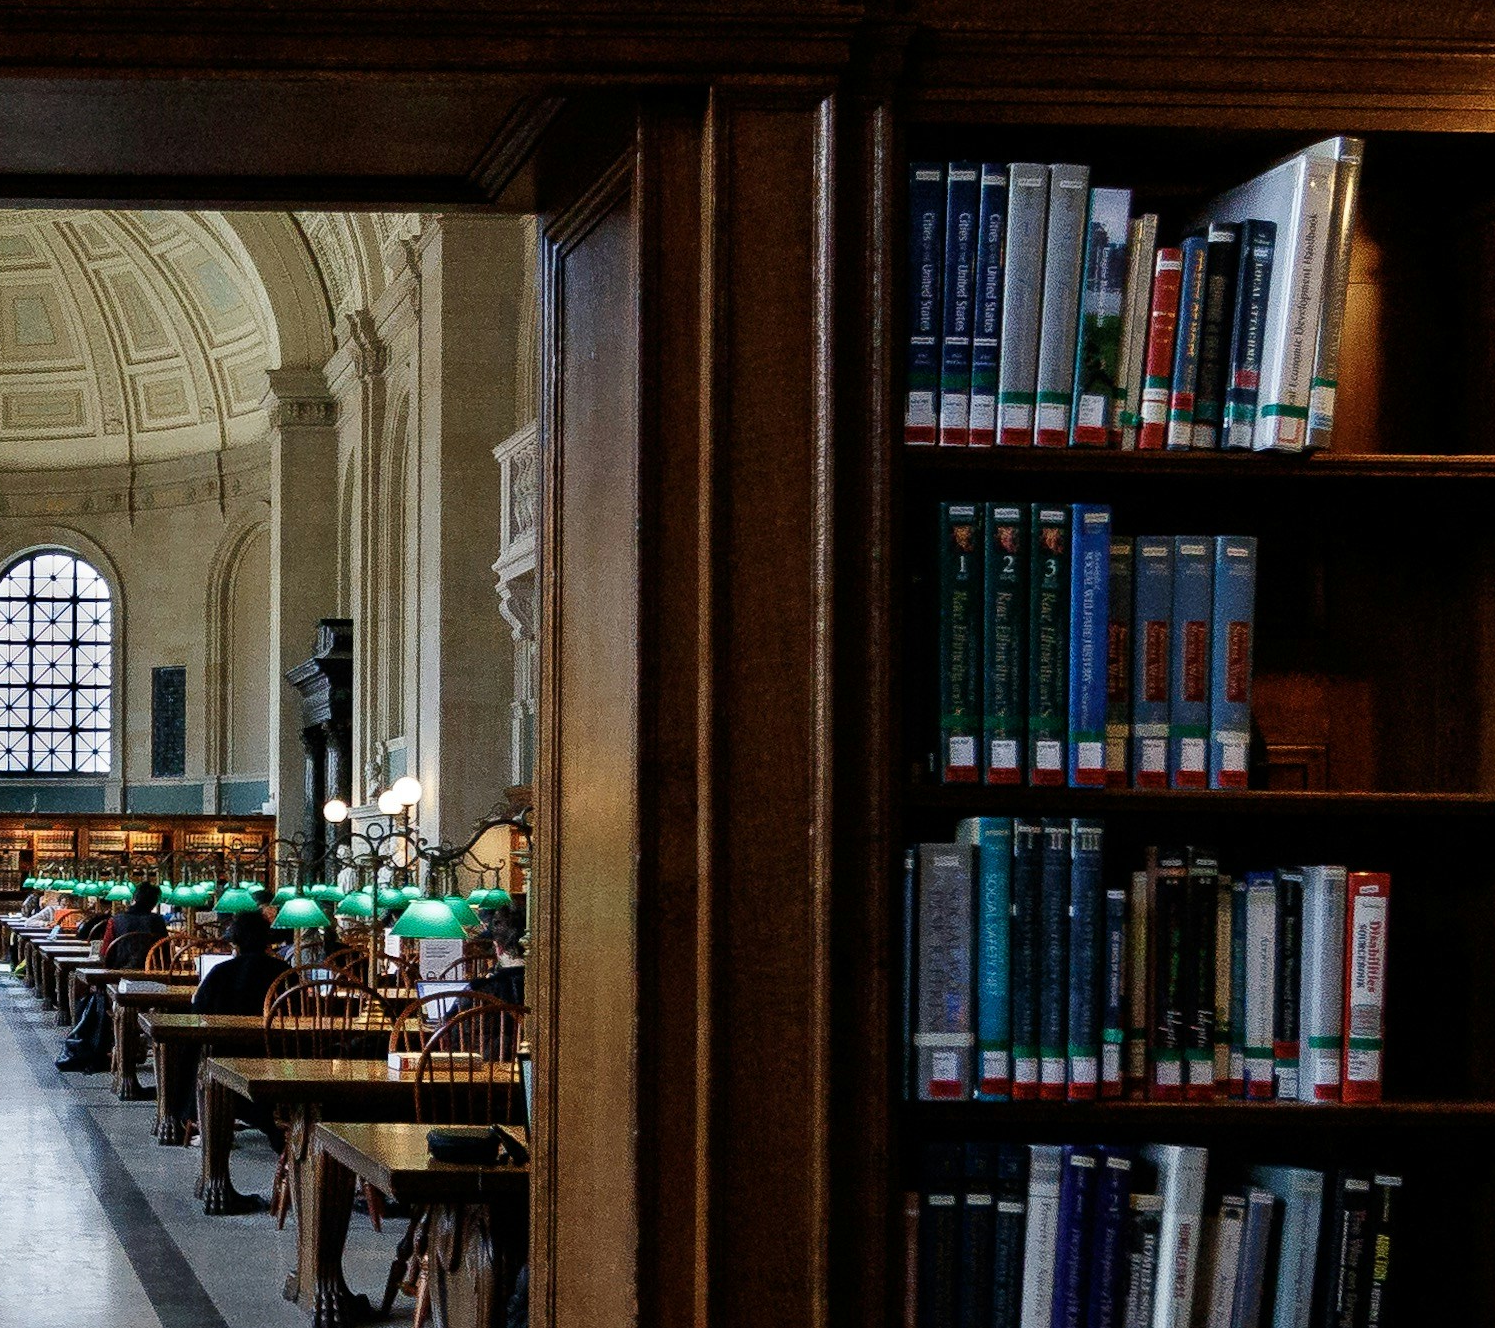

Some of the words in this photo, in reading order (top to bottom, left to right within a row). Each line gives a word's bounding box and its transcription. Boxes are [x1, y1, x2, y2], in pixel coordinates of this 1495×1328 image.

[958, 212, 972, 241] Cities
[989, 213, 1002, 243] Cities
[956, 265, 969, 298] United
[985, 265, 998, 298] United
[1252, 262, 1264, 298] LOCAL
[955, 300, 968, 333] States
[984, 300, 998, 333] States
[984, 873, 998, 918] SOCIAL
[984, 923, 998, 967] SAFETY
[1367, 921, 1382, 992] Disabilities
[985, 972, 999, 997] NET
